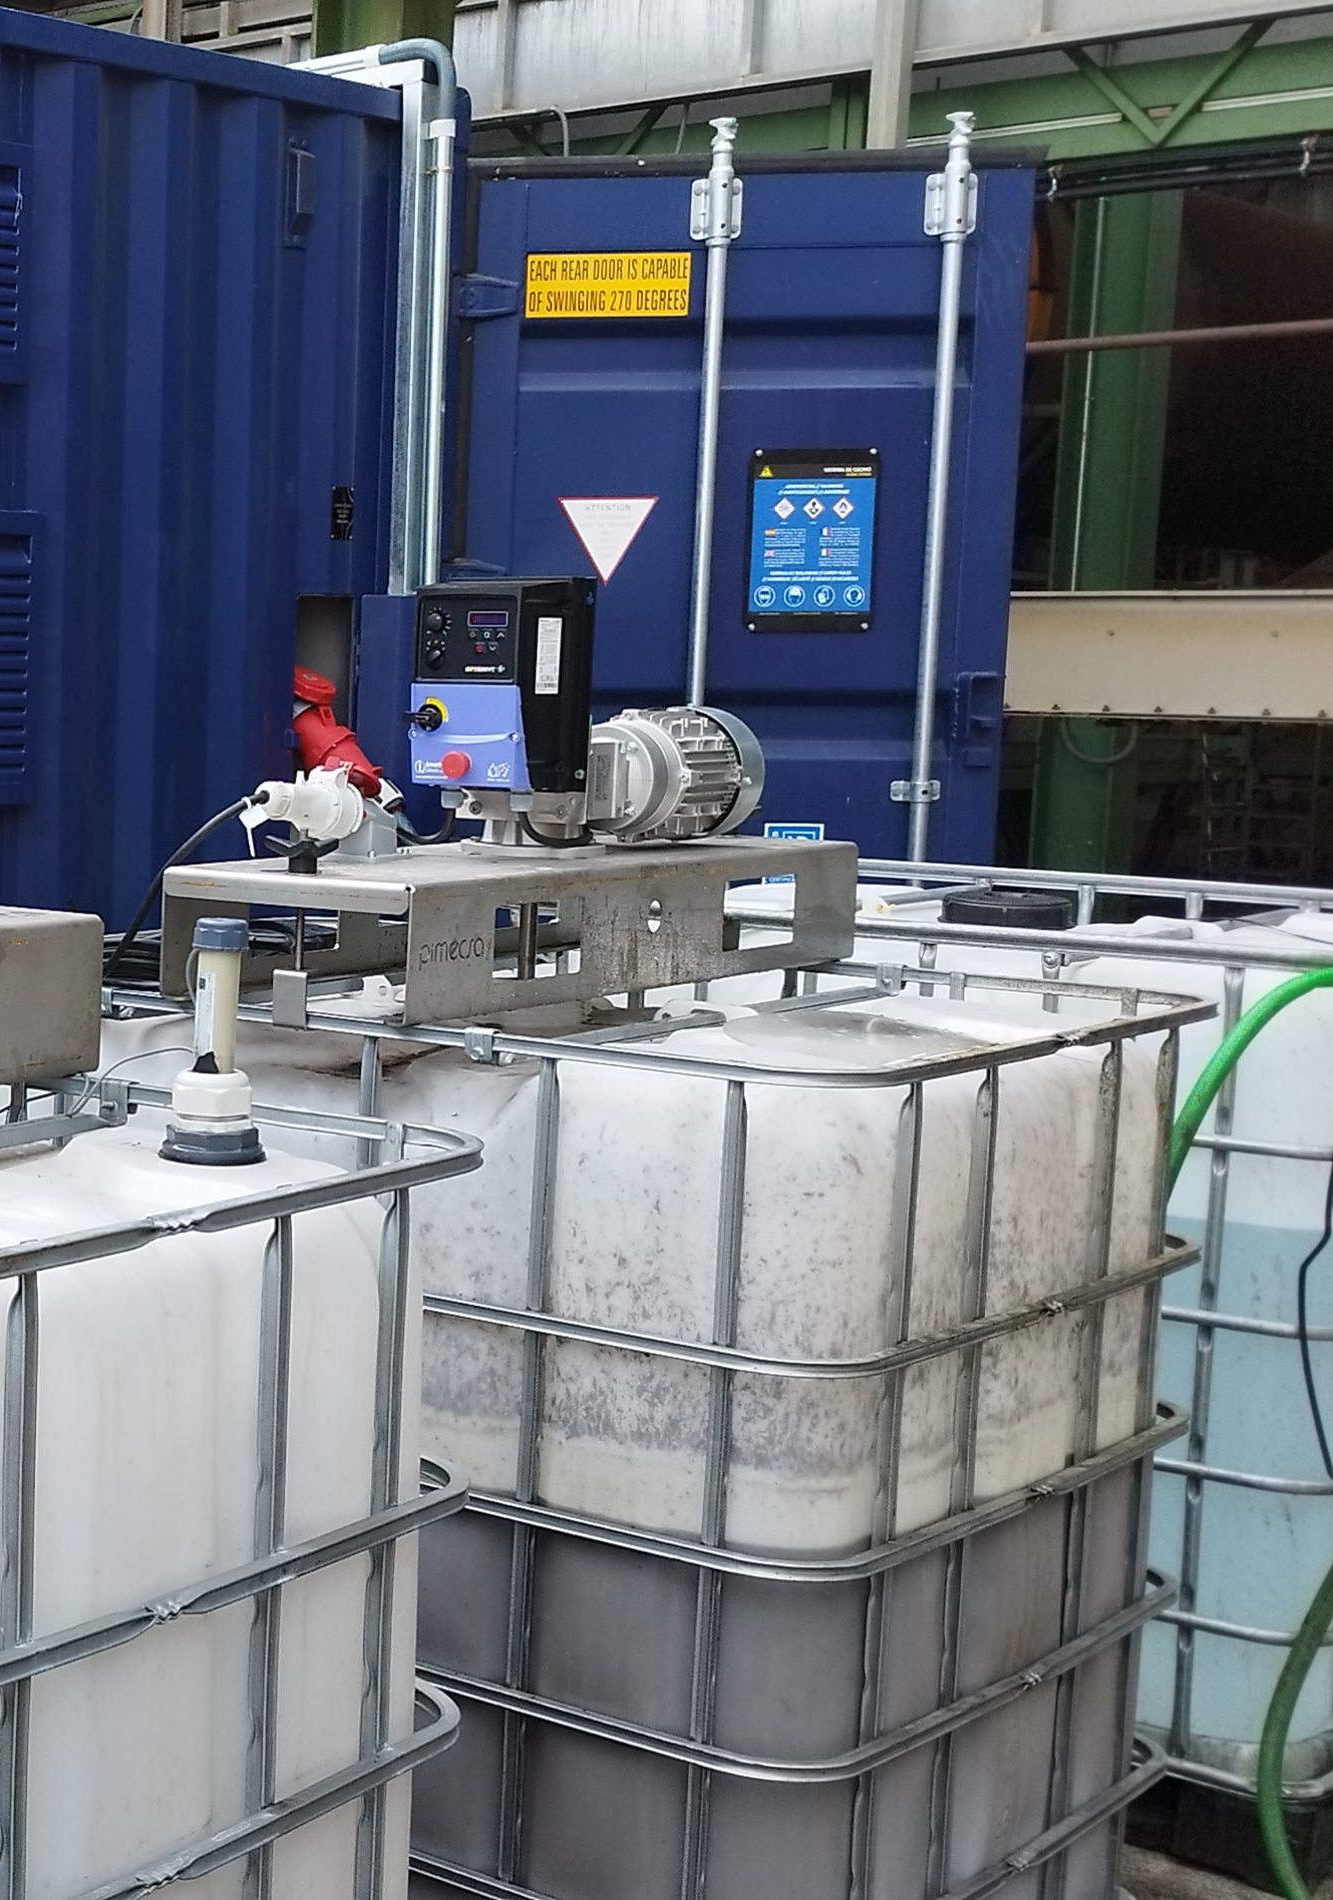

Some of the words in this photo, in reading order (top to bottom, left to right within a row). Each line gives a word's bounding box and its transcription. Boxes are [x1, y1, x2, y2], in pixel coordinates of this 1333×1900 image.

[529, 259, 558, 282] EACH
[561, 258, 589, 281] REAR
[593, 257, 623, 281] DOOR
[627, 257, 639, 280] IS
[641, 256, 689, 280] CAPABLE
[528, 290, 543, 312] OF
[546, 289, 606, 312] SWINGING
[610, 289, 632, 312] 270
[635, 288, 687, 311] DEGREES
